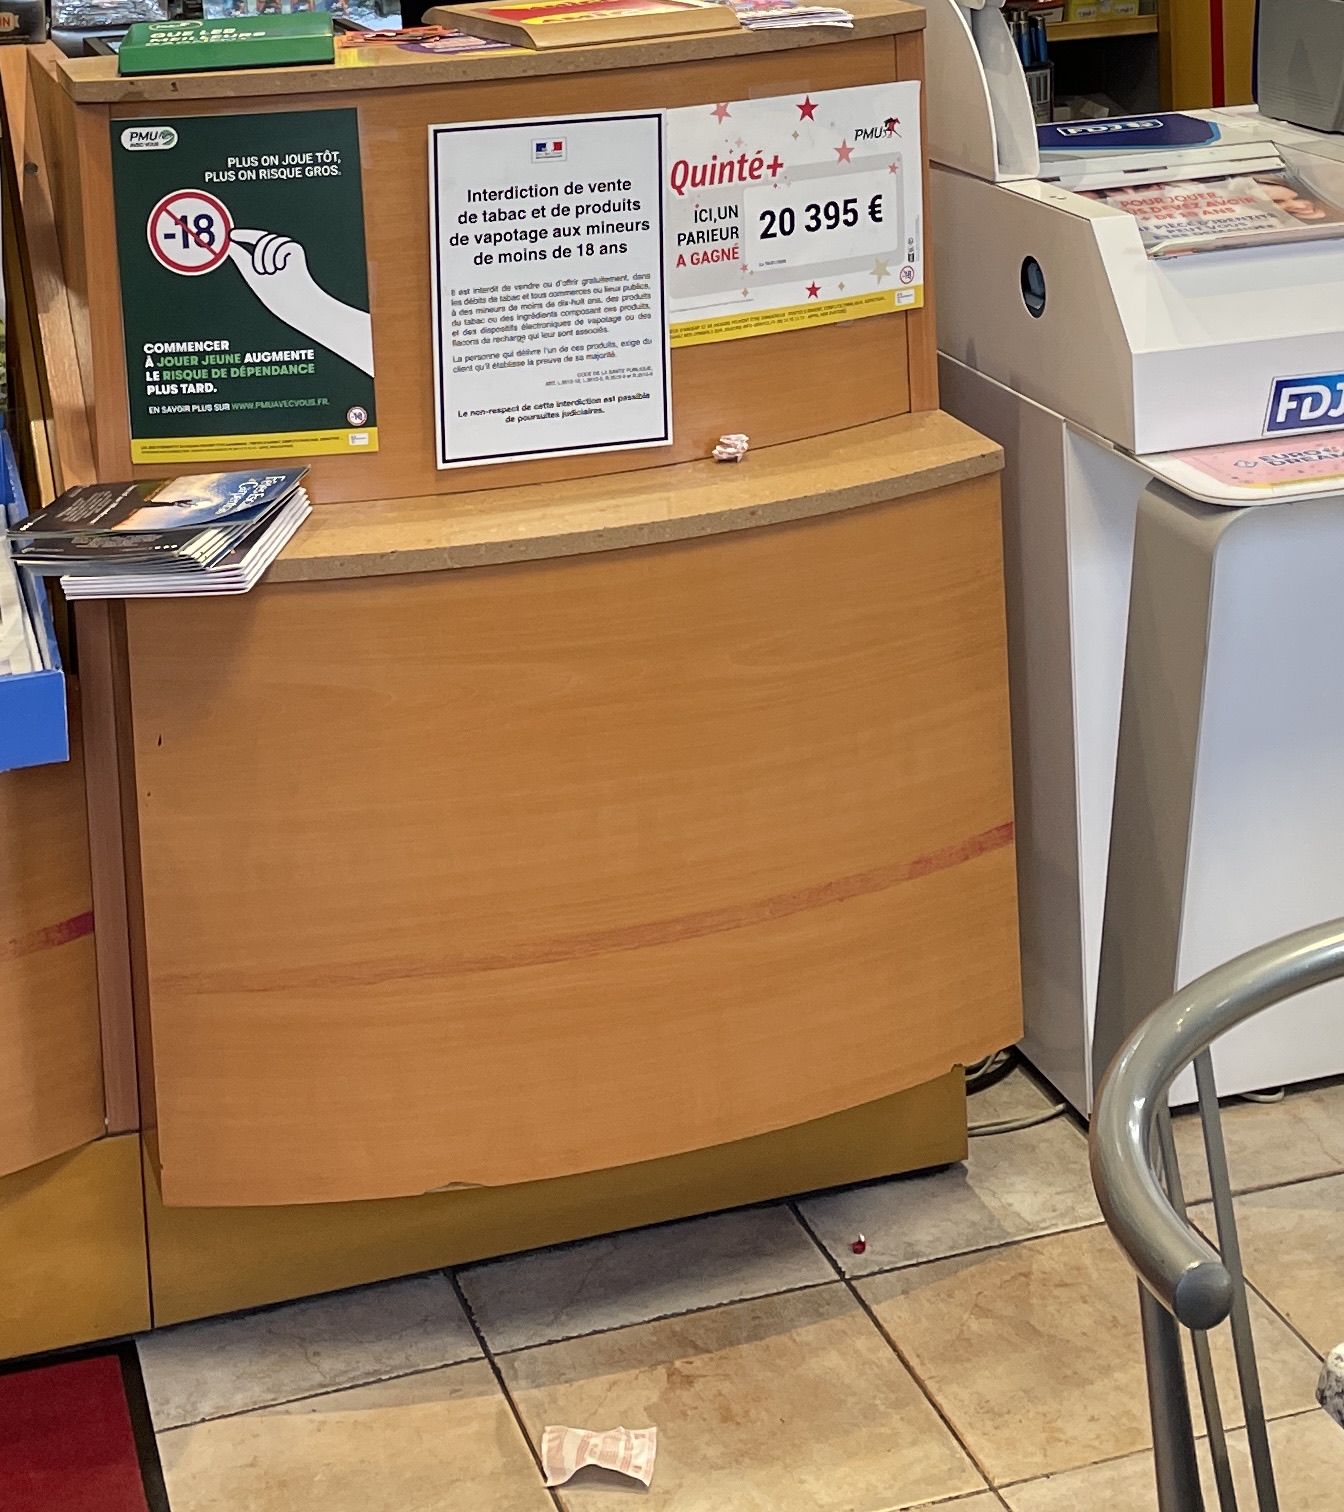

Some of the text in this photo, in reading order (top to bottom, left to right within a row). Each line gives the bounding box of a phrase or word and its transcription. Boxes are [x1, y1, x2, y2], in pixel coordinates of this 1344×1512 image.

[227, 150, 342, 168] PLUS ON JOUE TÔT,
[204, 164, 342, 183] PLUS ON RISQUE GROS.
[670, 149, 784, 196] Quinté+
[467, 178, 632, 203] Interdiction de vente
[458, 197, 641, 225] de tabac et de produits
[759, 193, 883, 240] 20 395 €
[163, 213, 216, 250] -18
[449, 219, 650, 247] de vapotage aux mineurs
[677, 225, 740, 247] PARIEUR
[473, 241, 628, 266] de moins de 18 ans
[675, 243, 740, 269] A GAGNÉ
[143, 339, 230, 354] COMMENCER
[144, 349, 315, 368] À JOUER JEUNE AUGMENTE
[145, 363, 315, 382] LE RISQUE DE DÉPENDANCE
[147, 383, 217, 396] PLUS TARD.
